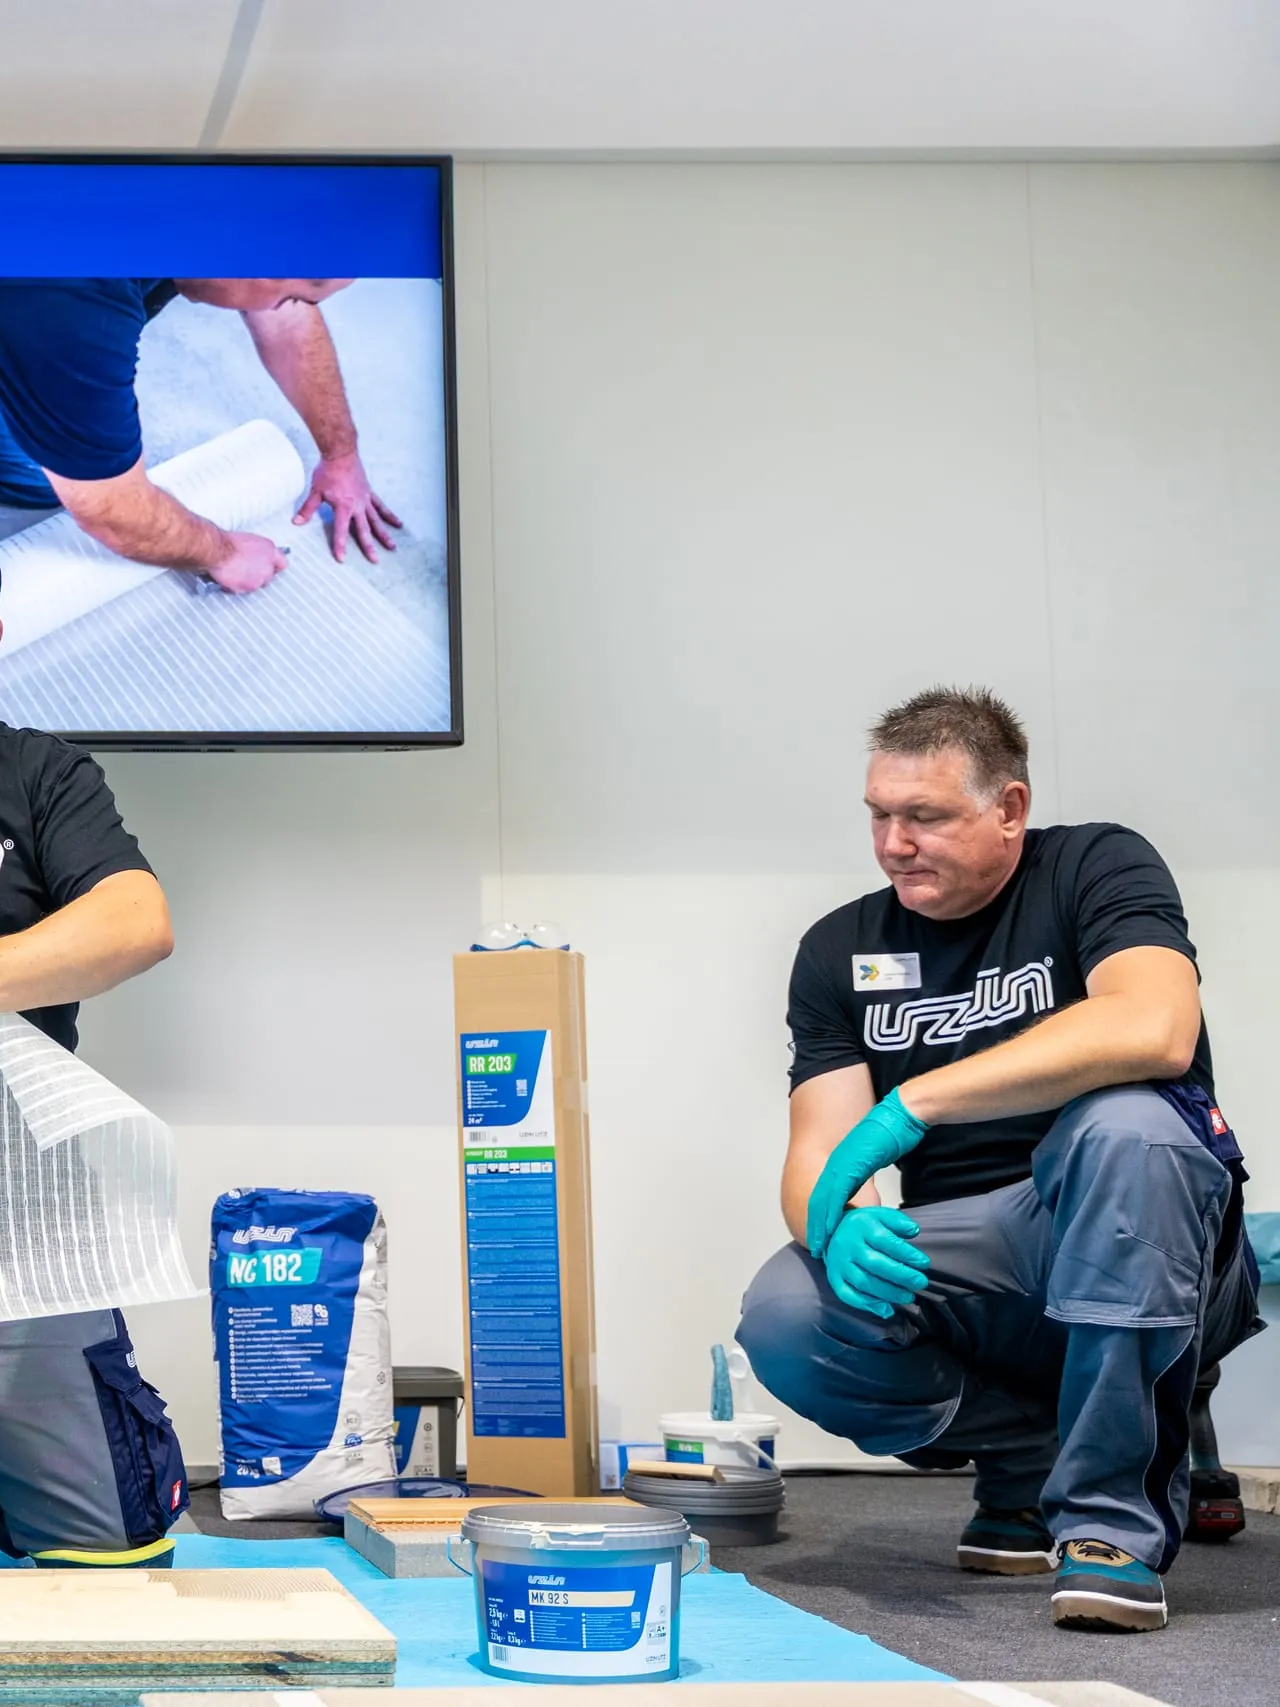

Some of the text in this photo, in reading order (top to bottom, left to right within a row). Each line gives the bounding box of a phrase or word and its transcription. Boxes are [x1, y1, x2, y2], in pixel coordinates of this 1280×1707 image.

[469, 1055, 512, 1073] RR 203
[230, 1253, 302, 1284] NC 182
[531, 1591, 569, 1605] MK 92 S
